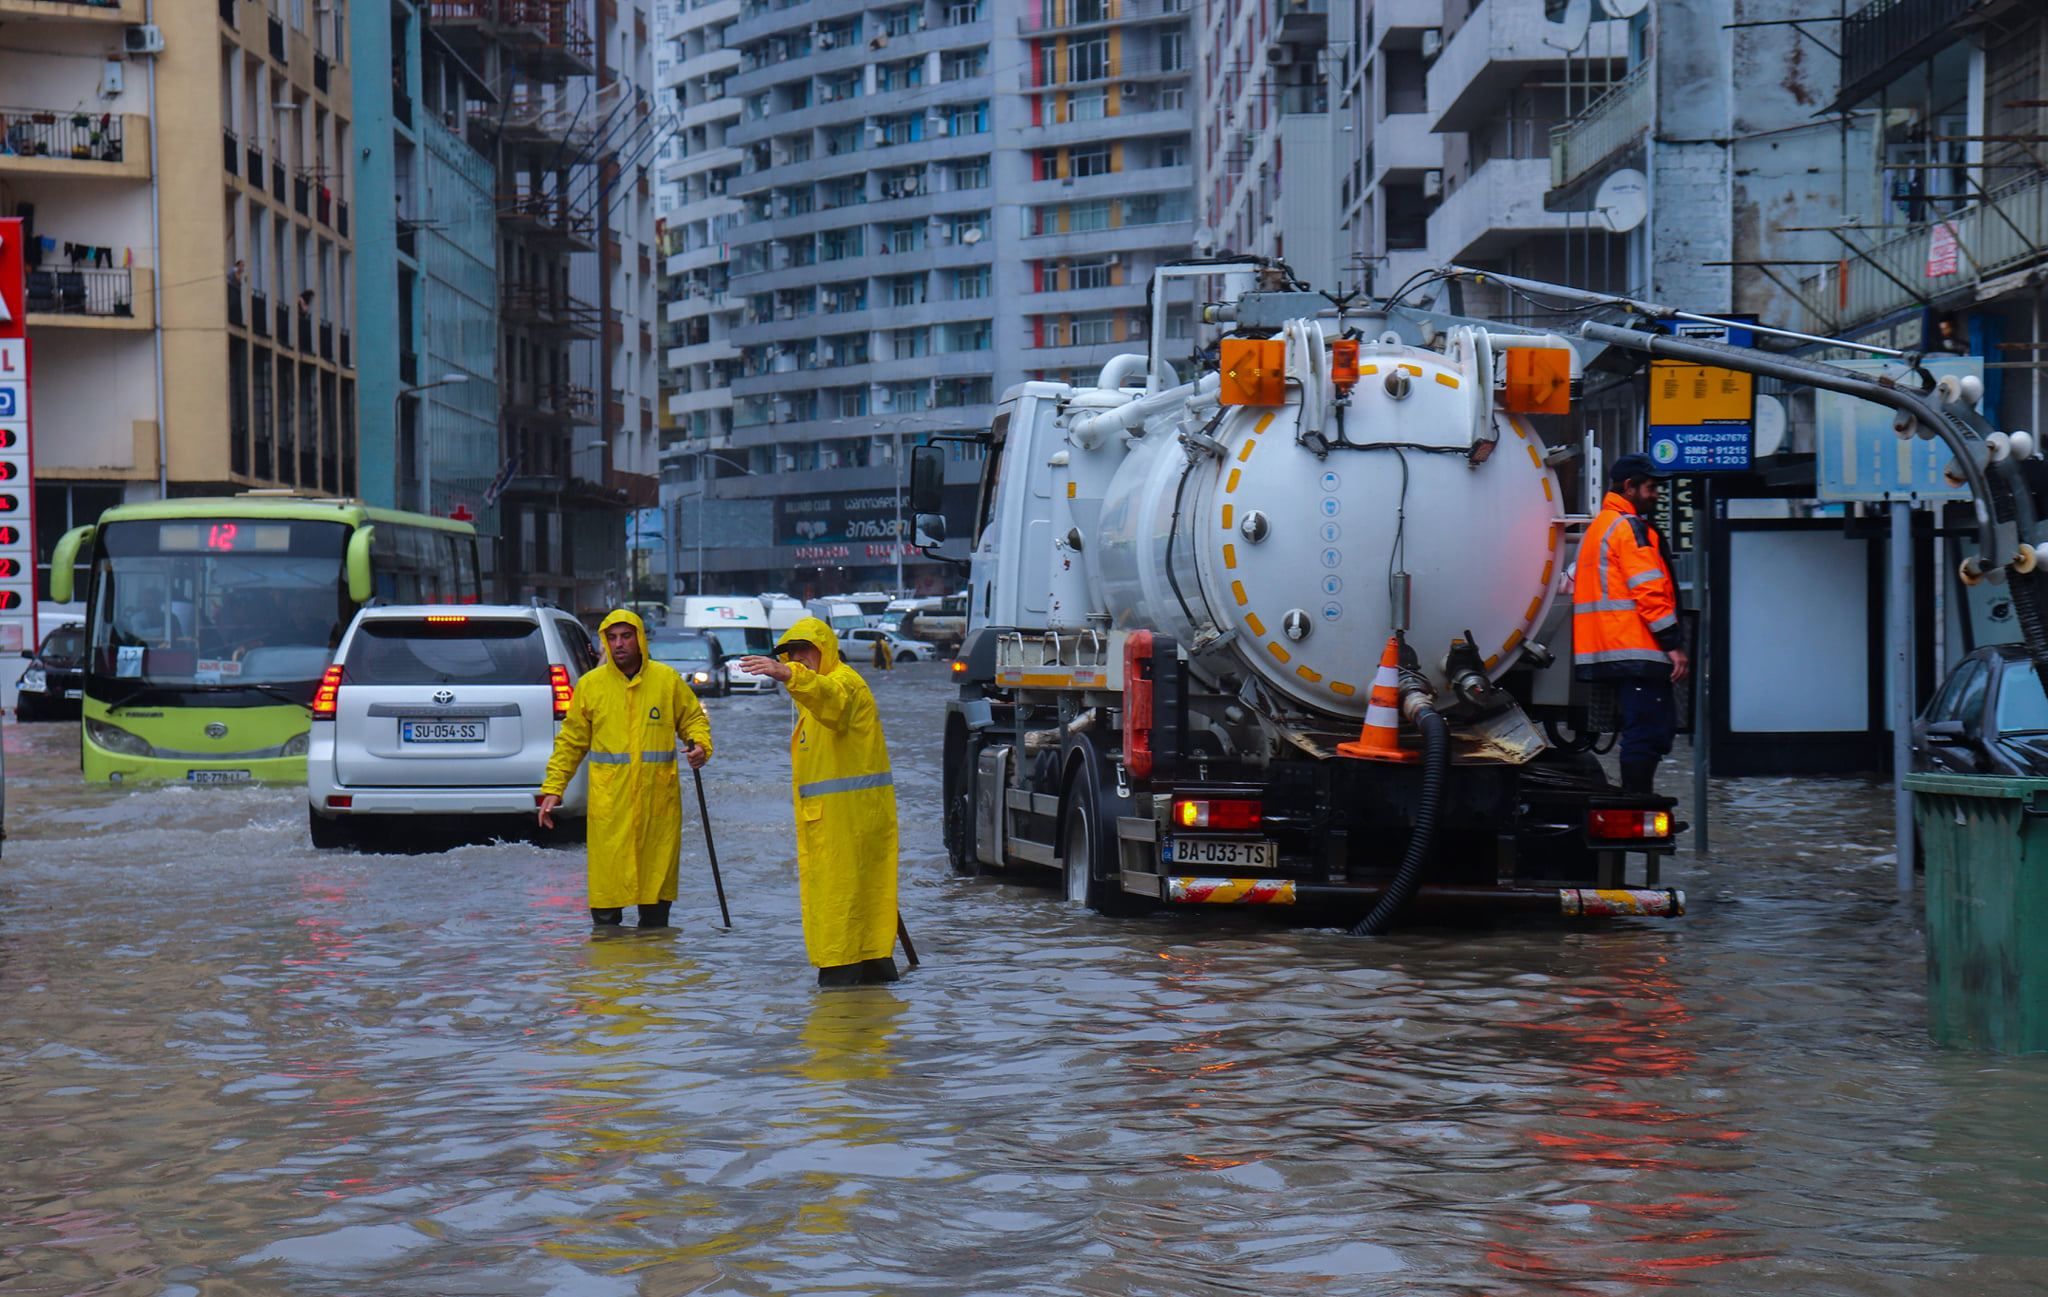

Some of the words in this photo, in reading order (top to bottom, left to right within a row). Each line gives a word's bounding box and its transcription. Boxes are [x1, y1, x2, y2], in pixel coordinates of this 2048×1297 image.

[1685, 446, 1708, 455] SMS
[1716, 446, 1748, 455] 91215
[1685, 456, 1708, 464] TEXT
[1715, 456, 1748, 464] 1203
[208, 523, 237, 552] 12
[123, 650, 138, 661] 12
[415, 725, 476, 738] SU-054-SS
[1178, 841, 1265, 864] BA-033-TS
